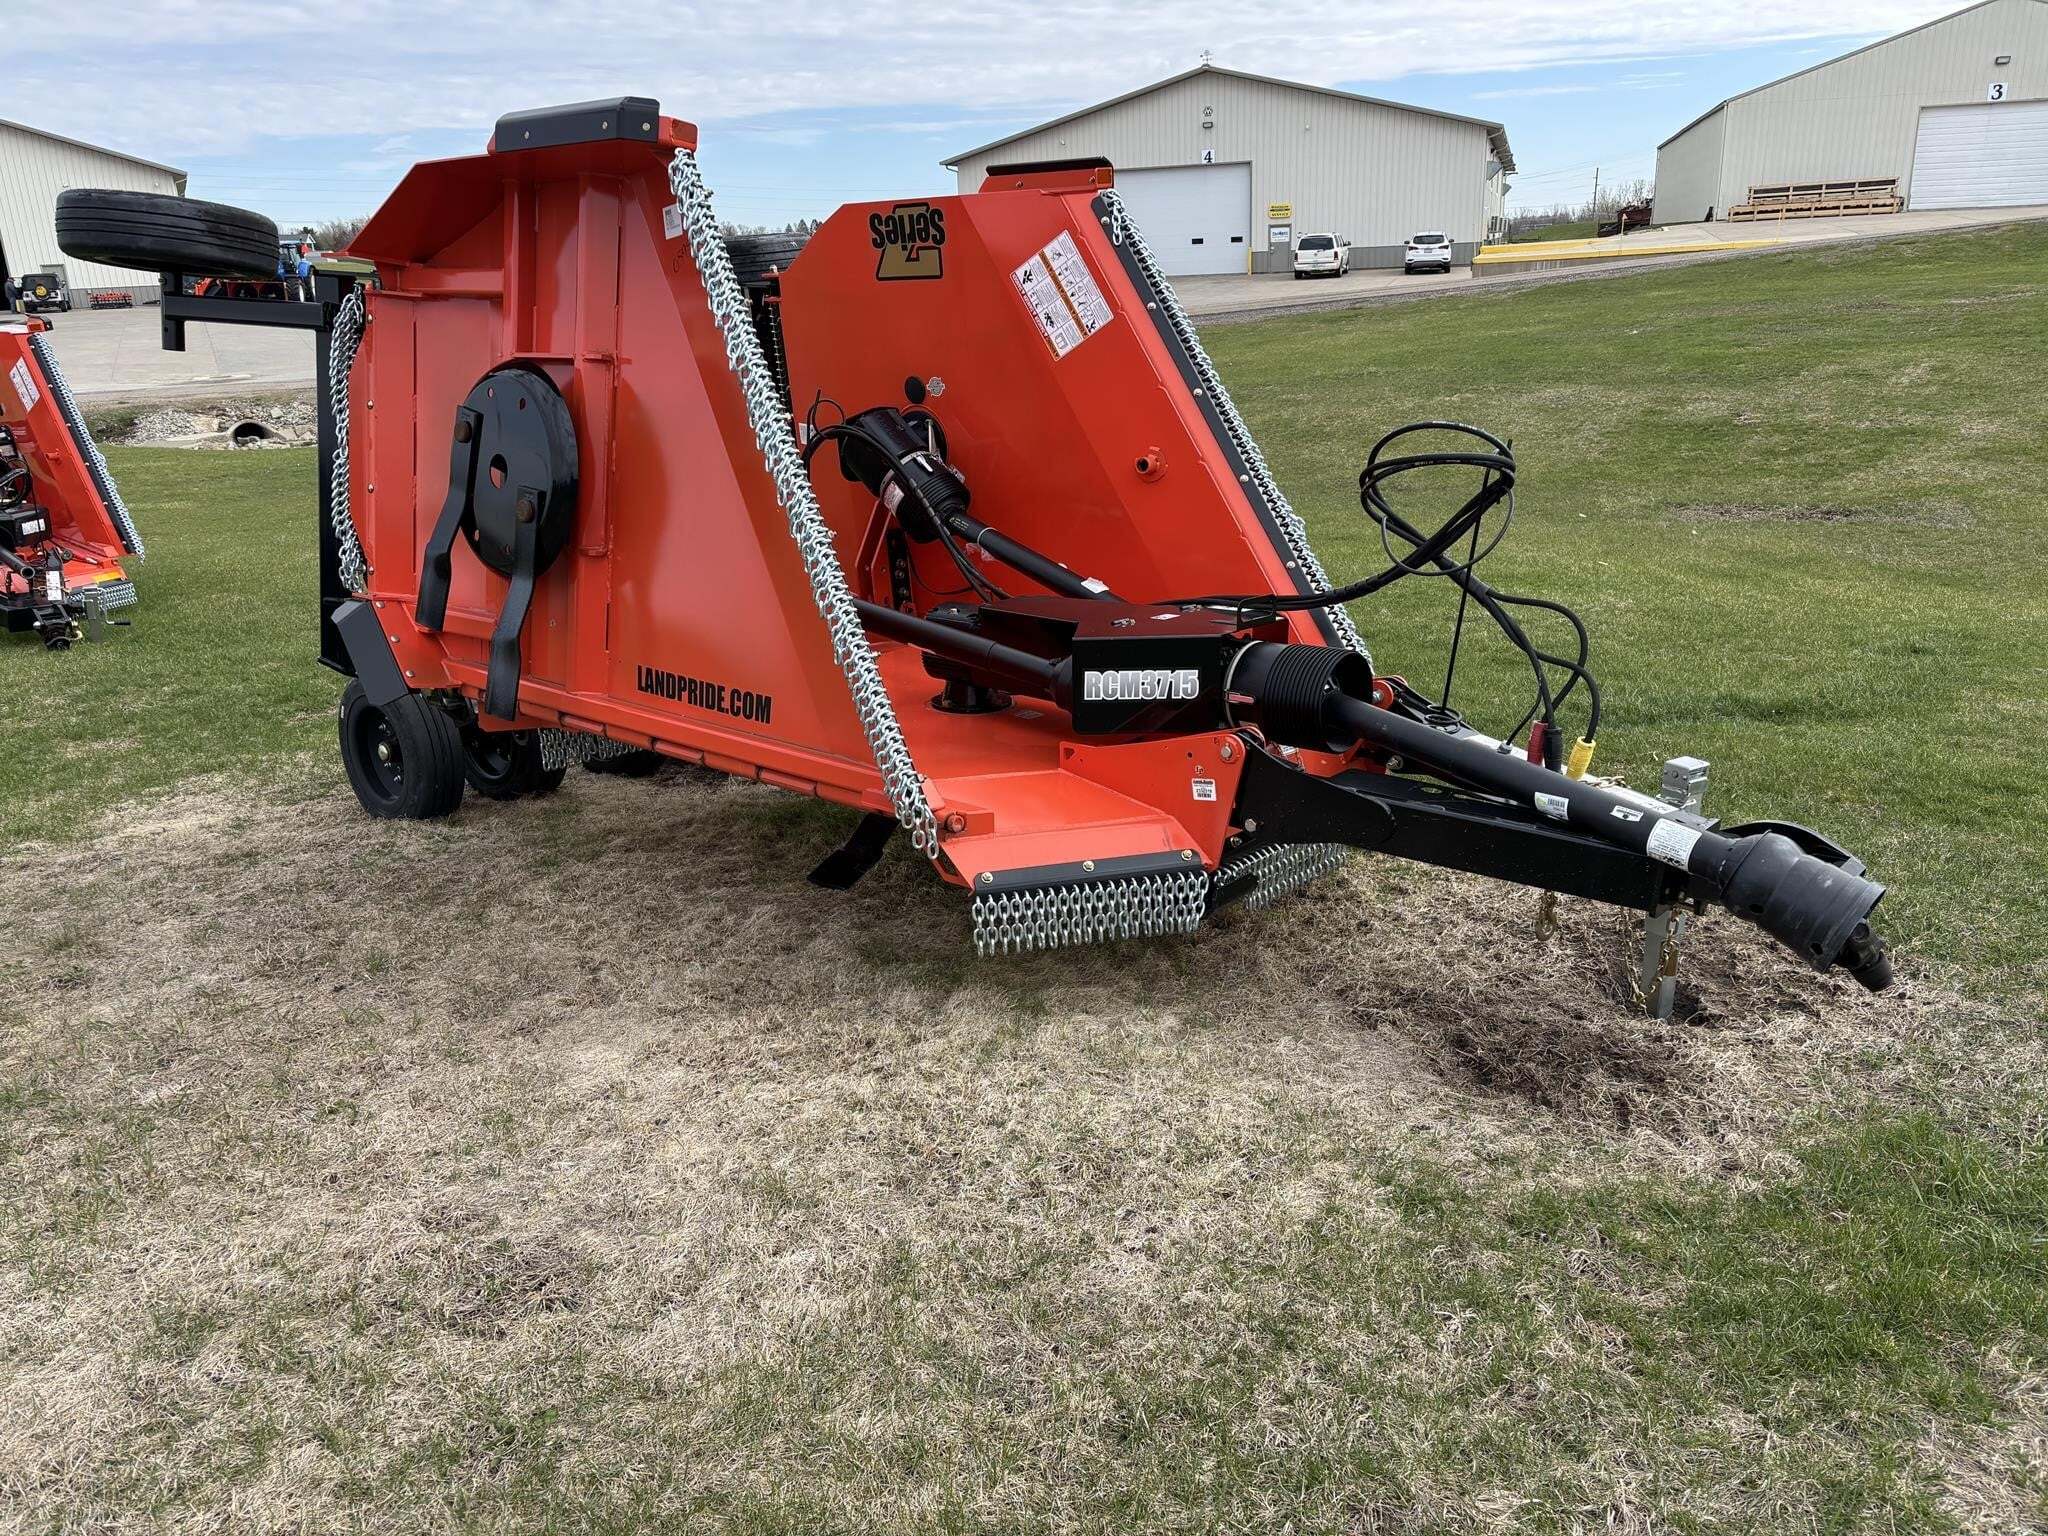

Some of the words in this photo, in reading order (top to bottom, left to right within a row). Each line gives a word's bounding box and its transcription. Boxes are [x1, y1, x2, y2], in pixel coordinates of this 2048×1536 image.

[1991, 84, 2003, 100] 3
[1204, 150, 1213, 163] 4
[637, 664, 772, 724] LANDPRIDE.COM
[1084, 669, 1200, 701] RCM3715
